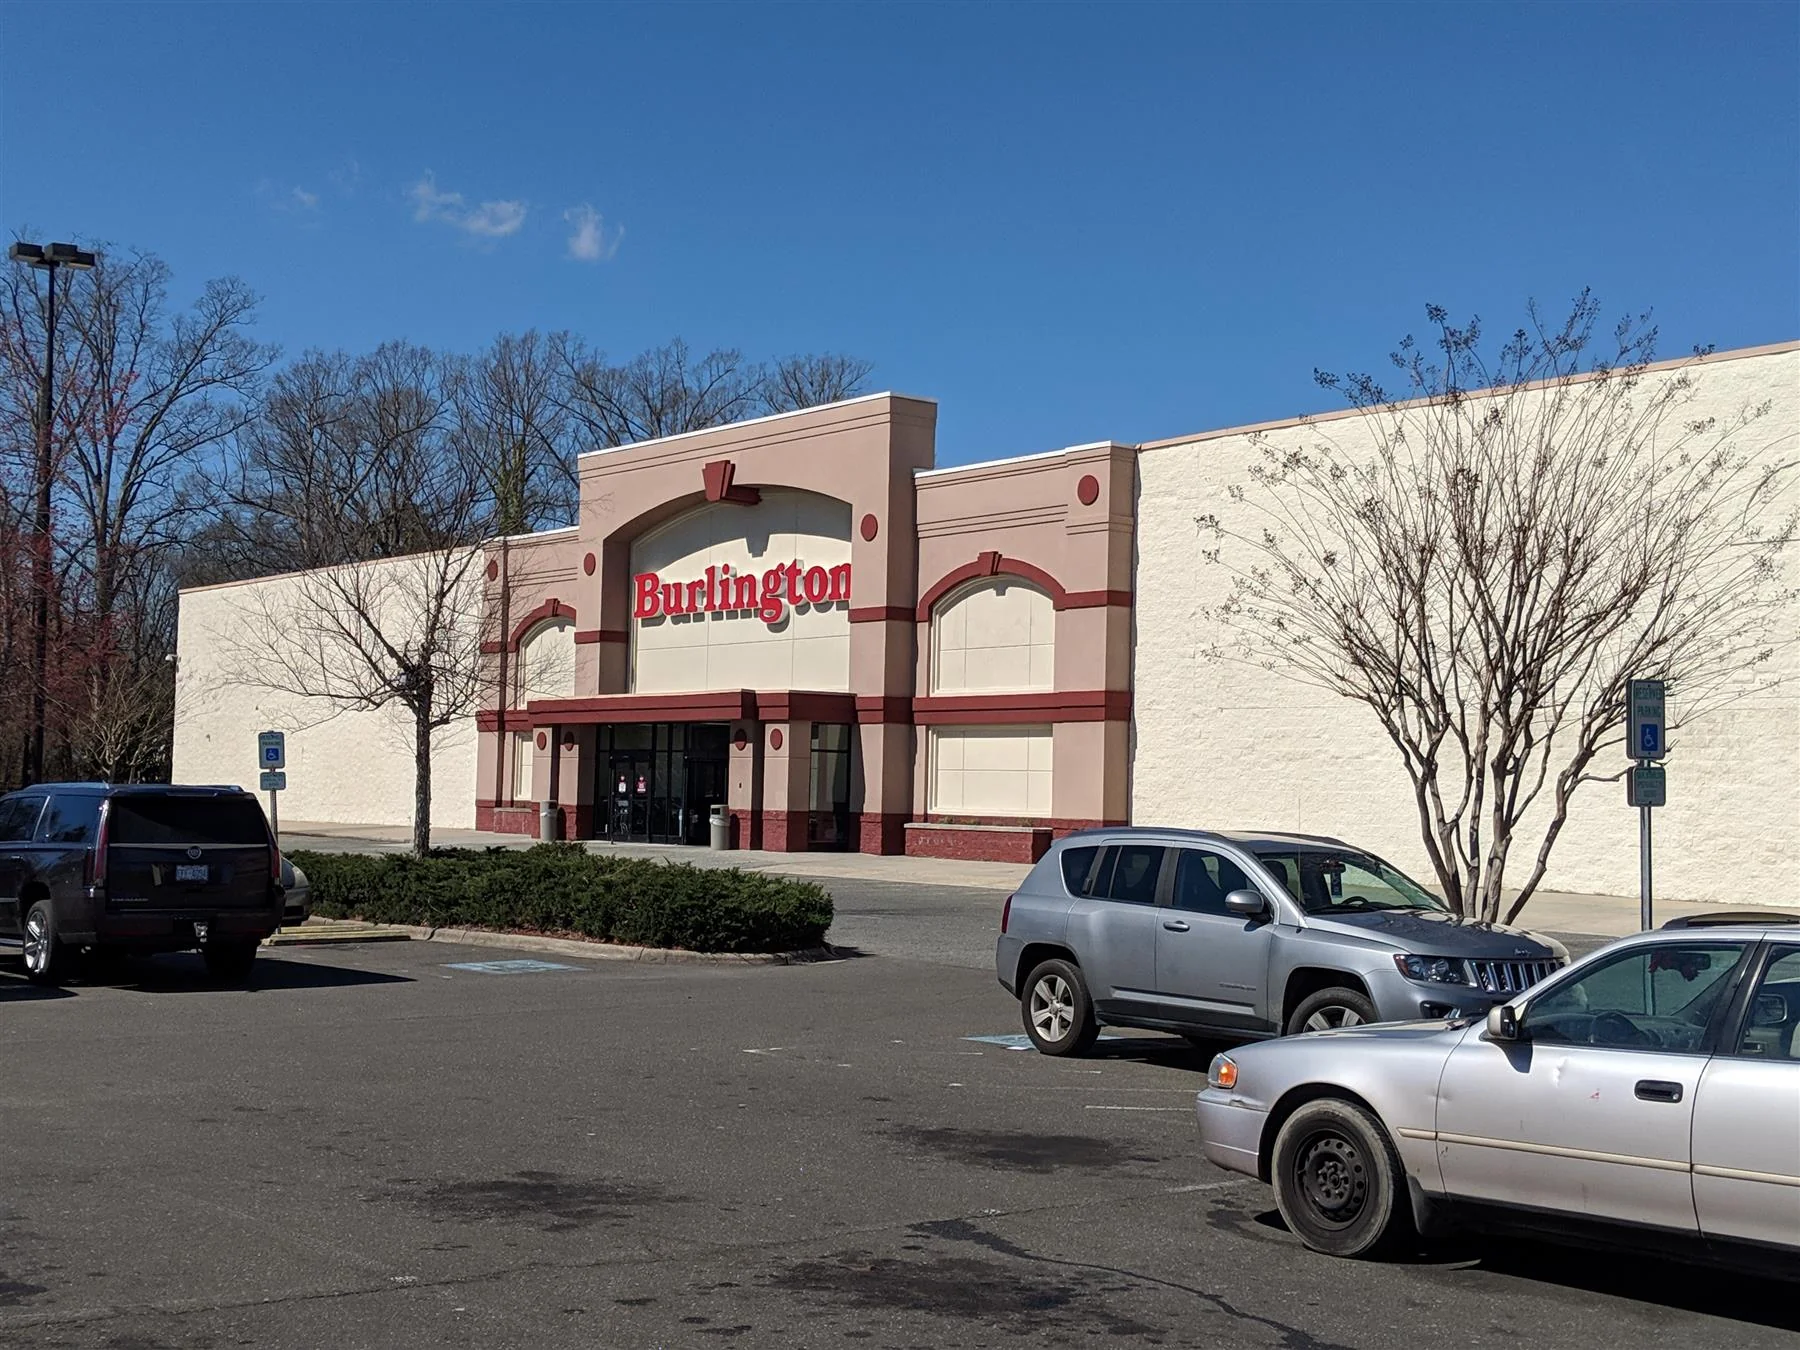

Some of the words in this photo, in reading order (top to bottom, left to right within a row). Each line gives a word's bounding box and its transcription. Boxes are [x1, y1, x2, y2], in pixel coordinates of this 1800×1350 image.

[633, 559, 852, 623] Burlington
[1635, 687, 1662, 700] RESERVED
[1637, 705, 1662, 718] PARKING
